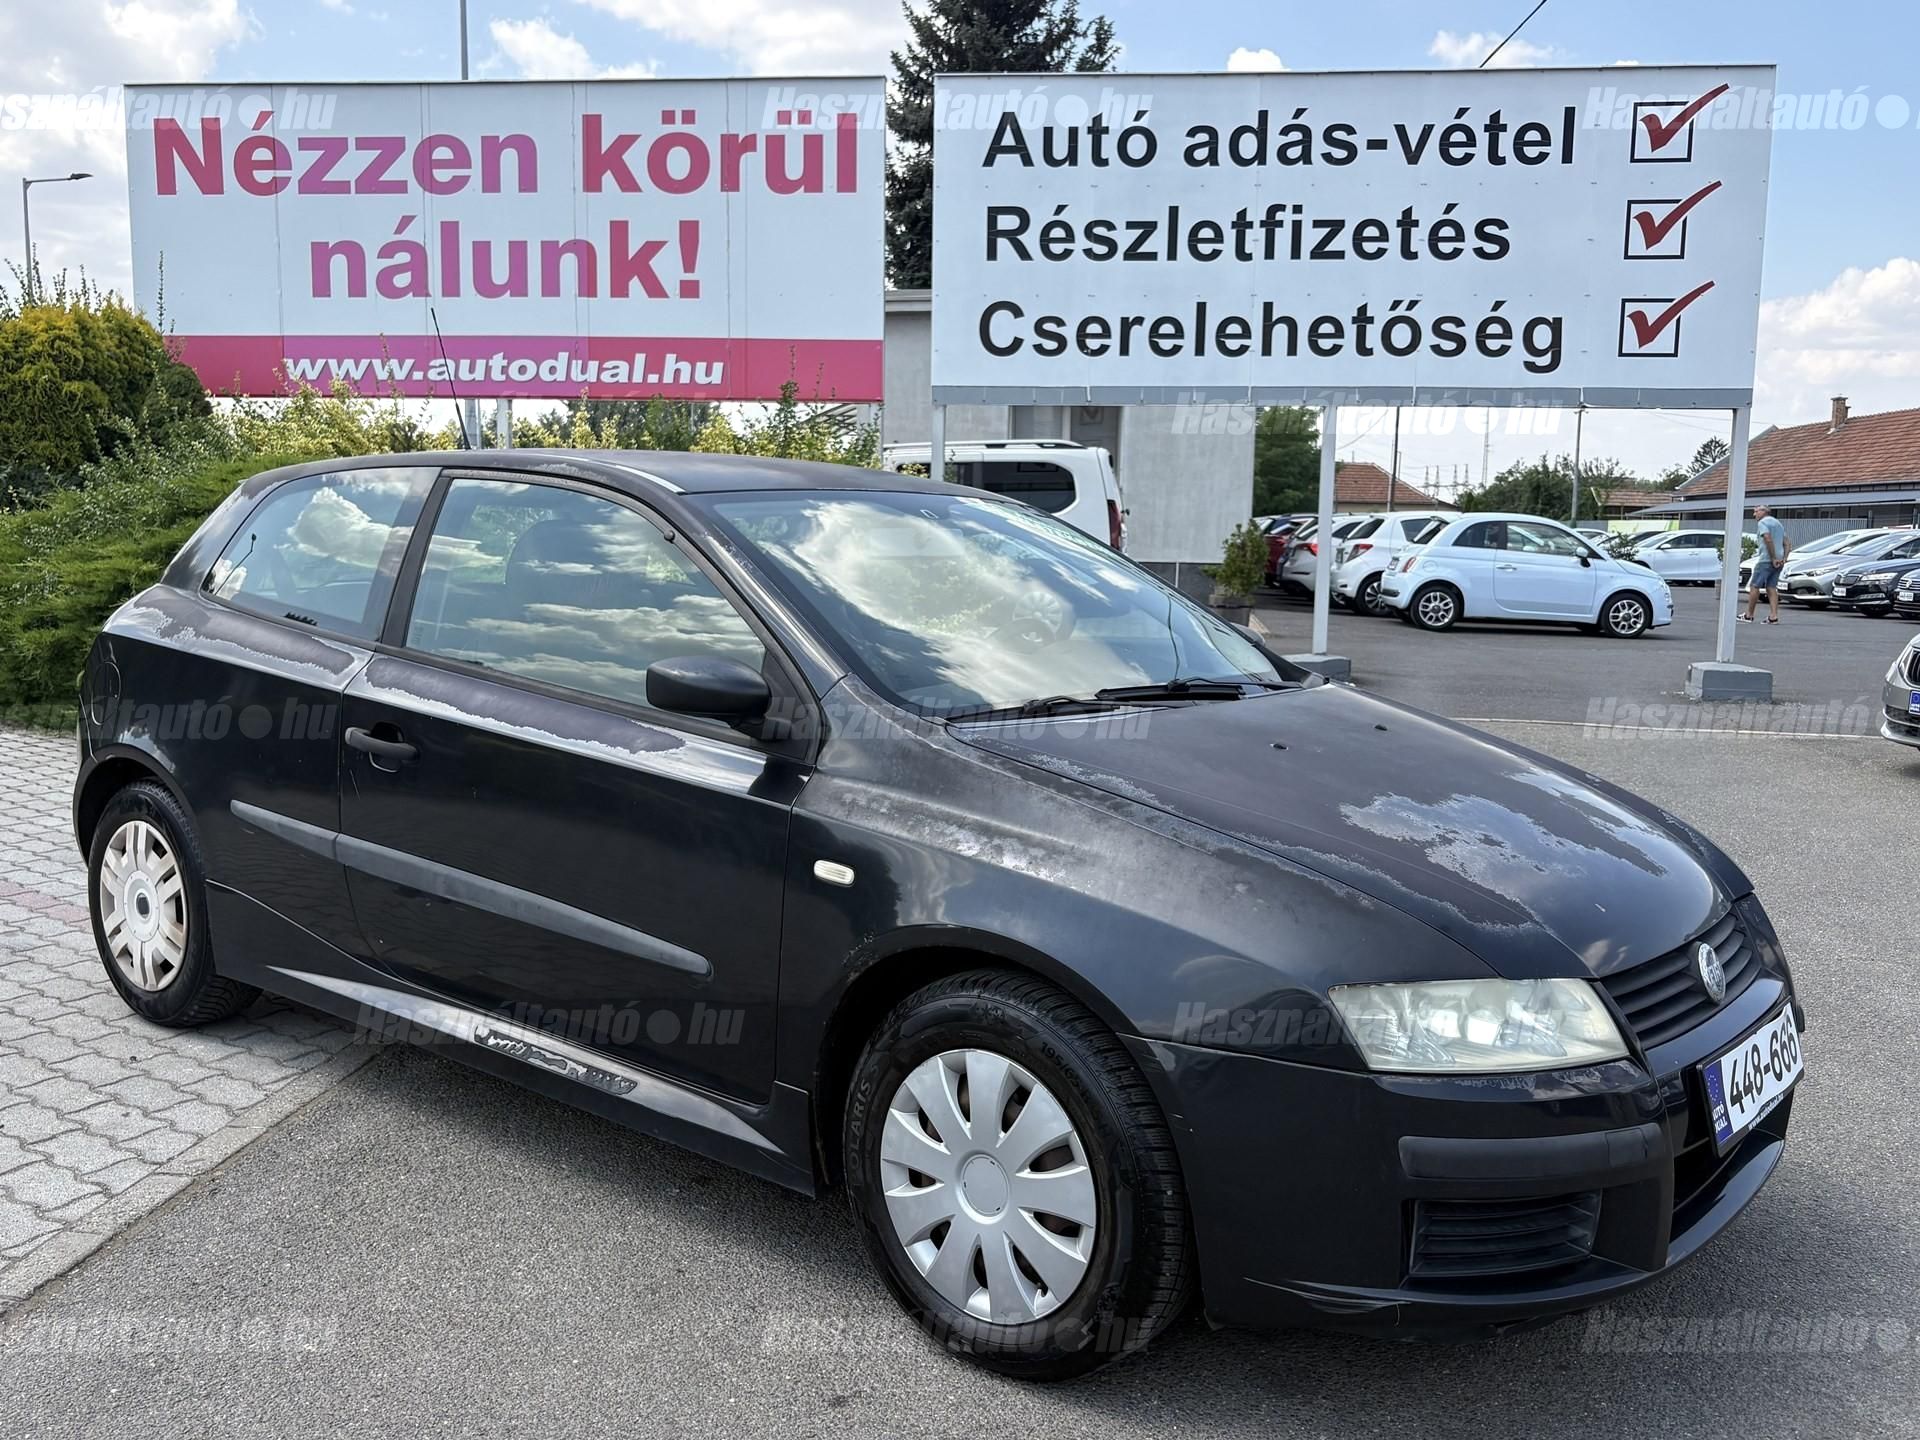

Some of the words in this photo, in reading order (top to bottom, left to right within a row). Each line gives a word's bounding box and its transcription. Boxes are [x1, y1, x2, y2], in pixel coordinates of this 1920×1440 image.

[153, 110, 538, 196] Nézzen
[582, 109, 857, 194] körül
[983, 108, 1158, 169] Autó
[1184, 106, 1576, 169] adás-vétel
[310, 215, 701, 299] nálunk!
[985, 202, 1512, 262] Részletfizetés
[284, 352, 724, 385] www.autodual.hu
[978, 298, 1564, 373] Cserelehetőség
[1729, 1014, 1798, 1114] 448-666
